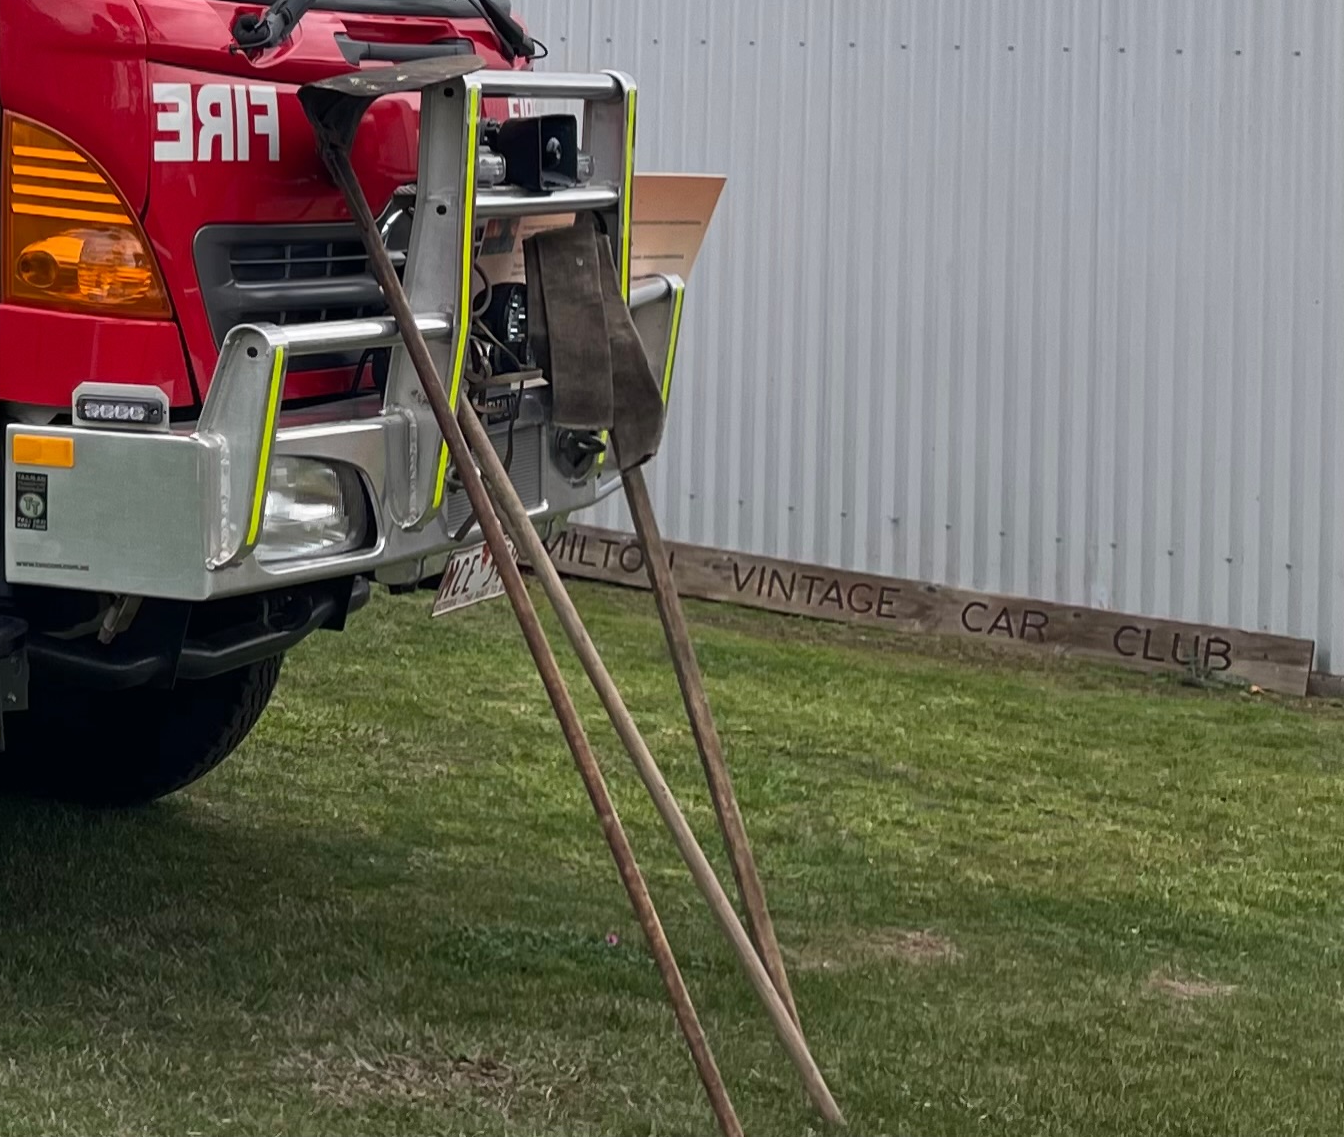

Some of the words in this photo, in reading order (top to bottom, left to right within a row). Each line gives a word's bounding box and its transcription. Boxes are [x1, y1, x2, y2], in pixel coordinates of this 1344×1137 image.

[543, 529, 675, 574] MILTO
[732, 562, 902, 620] VINTAGE
[961, 601, 1050, 643] CAR
[1113, 624, 1233, 673] CLUB
